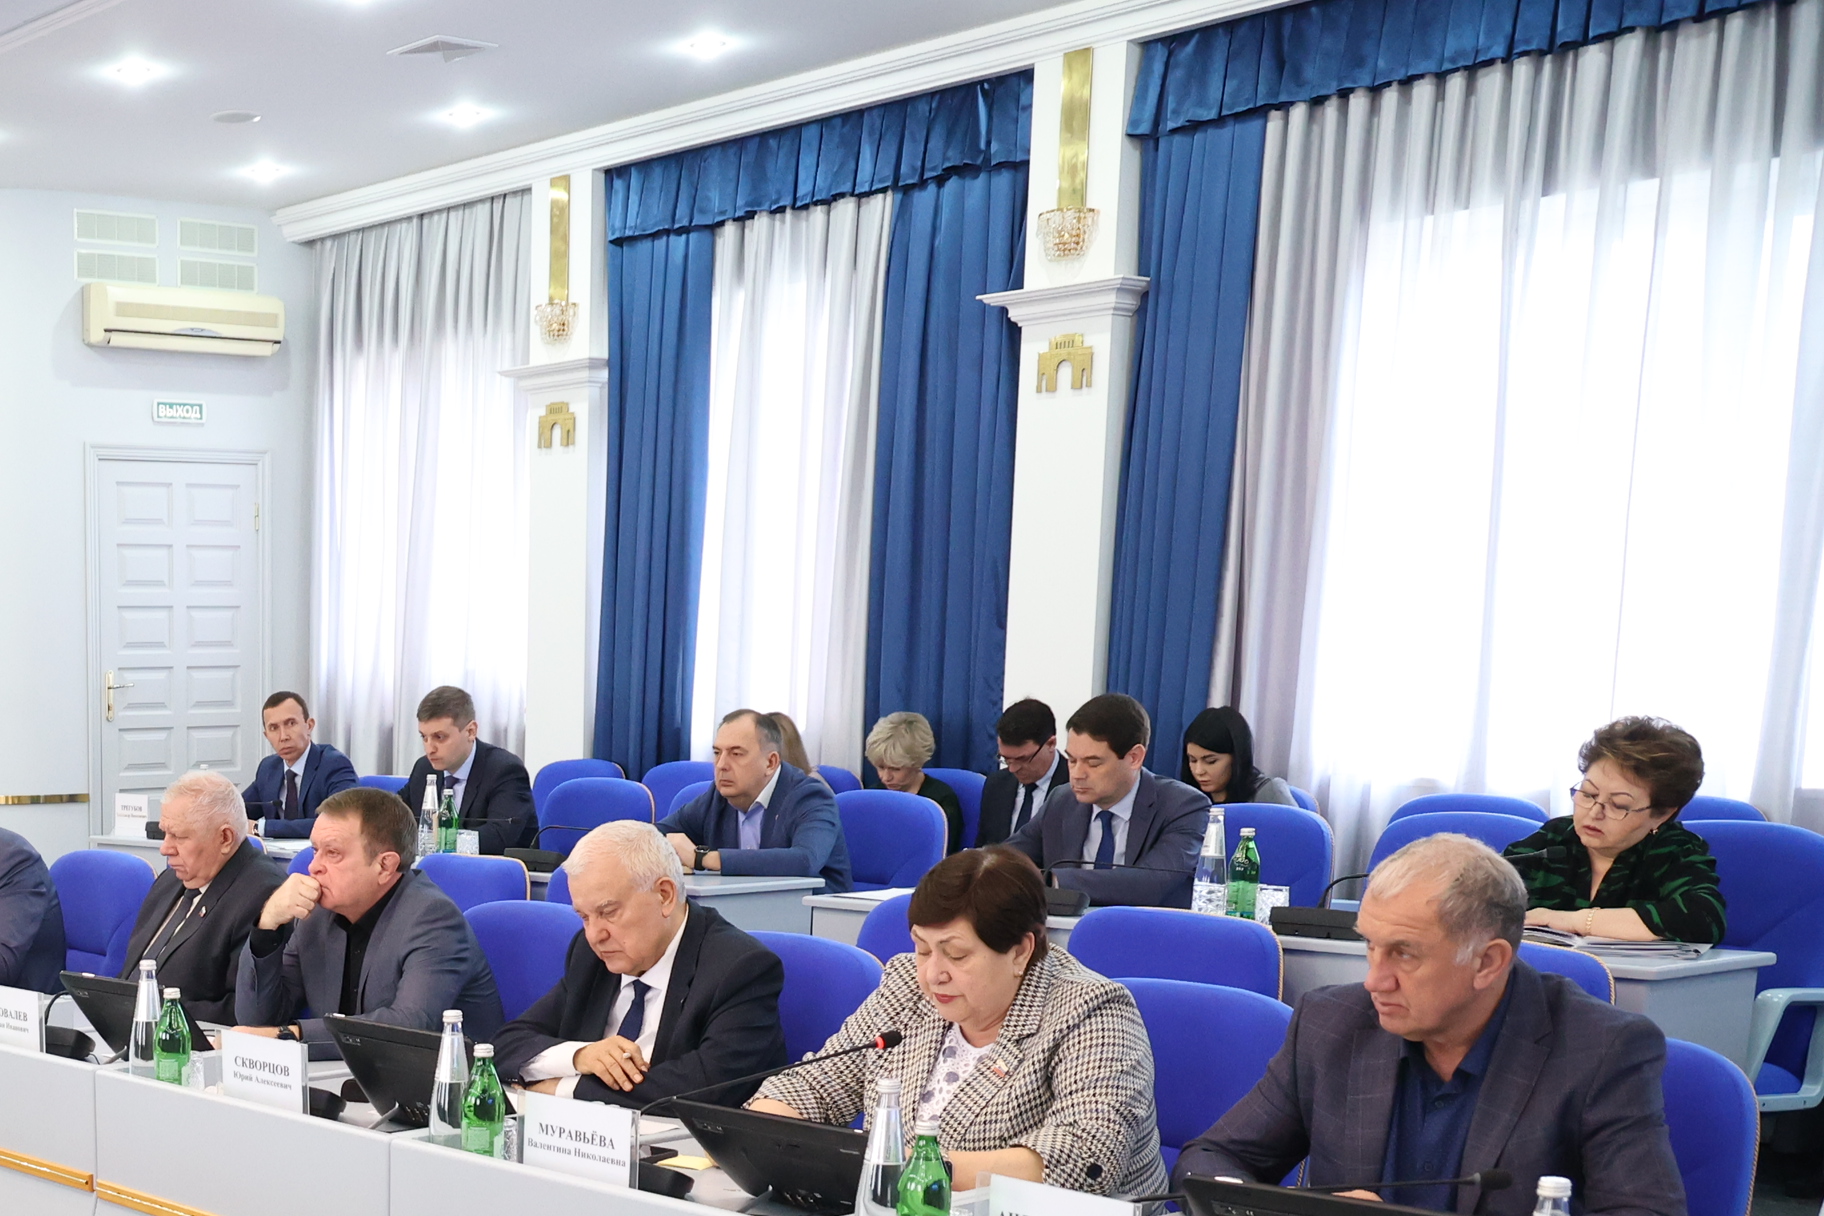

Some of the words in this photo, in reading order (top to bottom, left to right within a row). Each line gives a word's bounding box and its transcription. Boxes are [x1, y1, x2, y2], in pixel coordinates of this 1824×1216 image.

[158, 403, 201, 419] ВЫХОД
[234, 1055, 290, 1077] СКВОРЦОВ
[233, 1070, 253, 1082] Юрий
[254, 1076, 292, 1090] Алексеевич
[538, 1122, 616, 1150] МУРАВЬЁВА
[527, 1137, 572, 1156] Валентина
[574, 1147, 627, 1168] Николаевна
